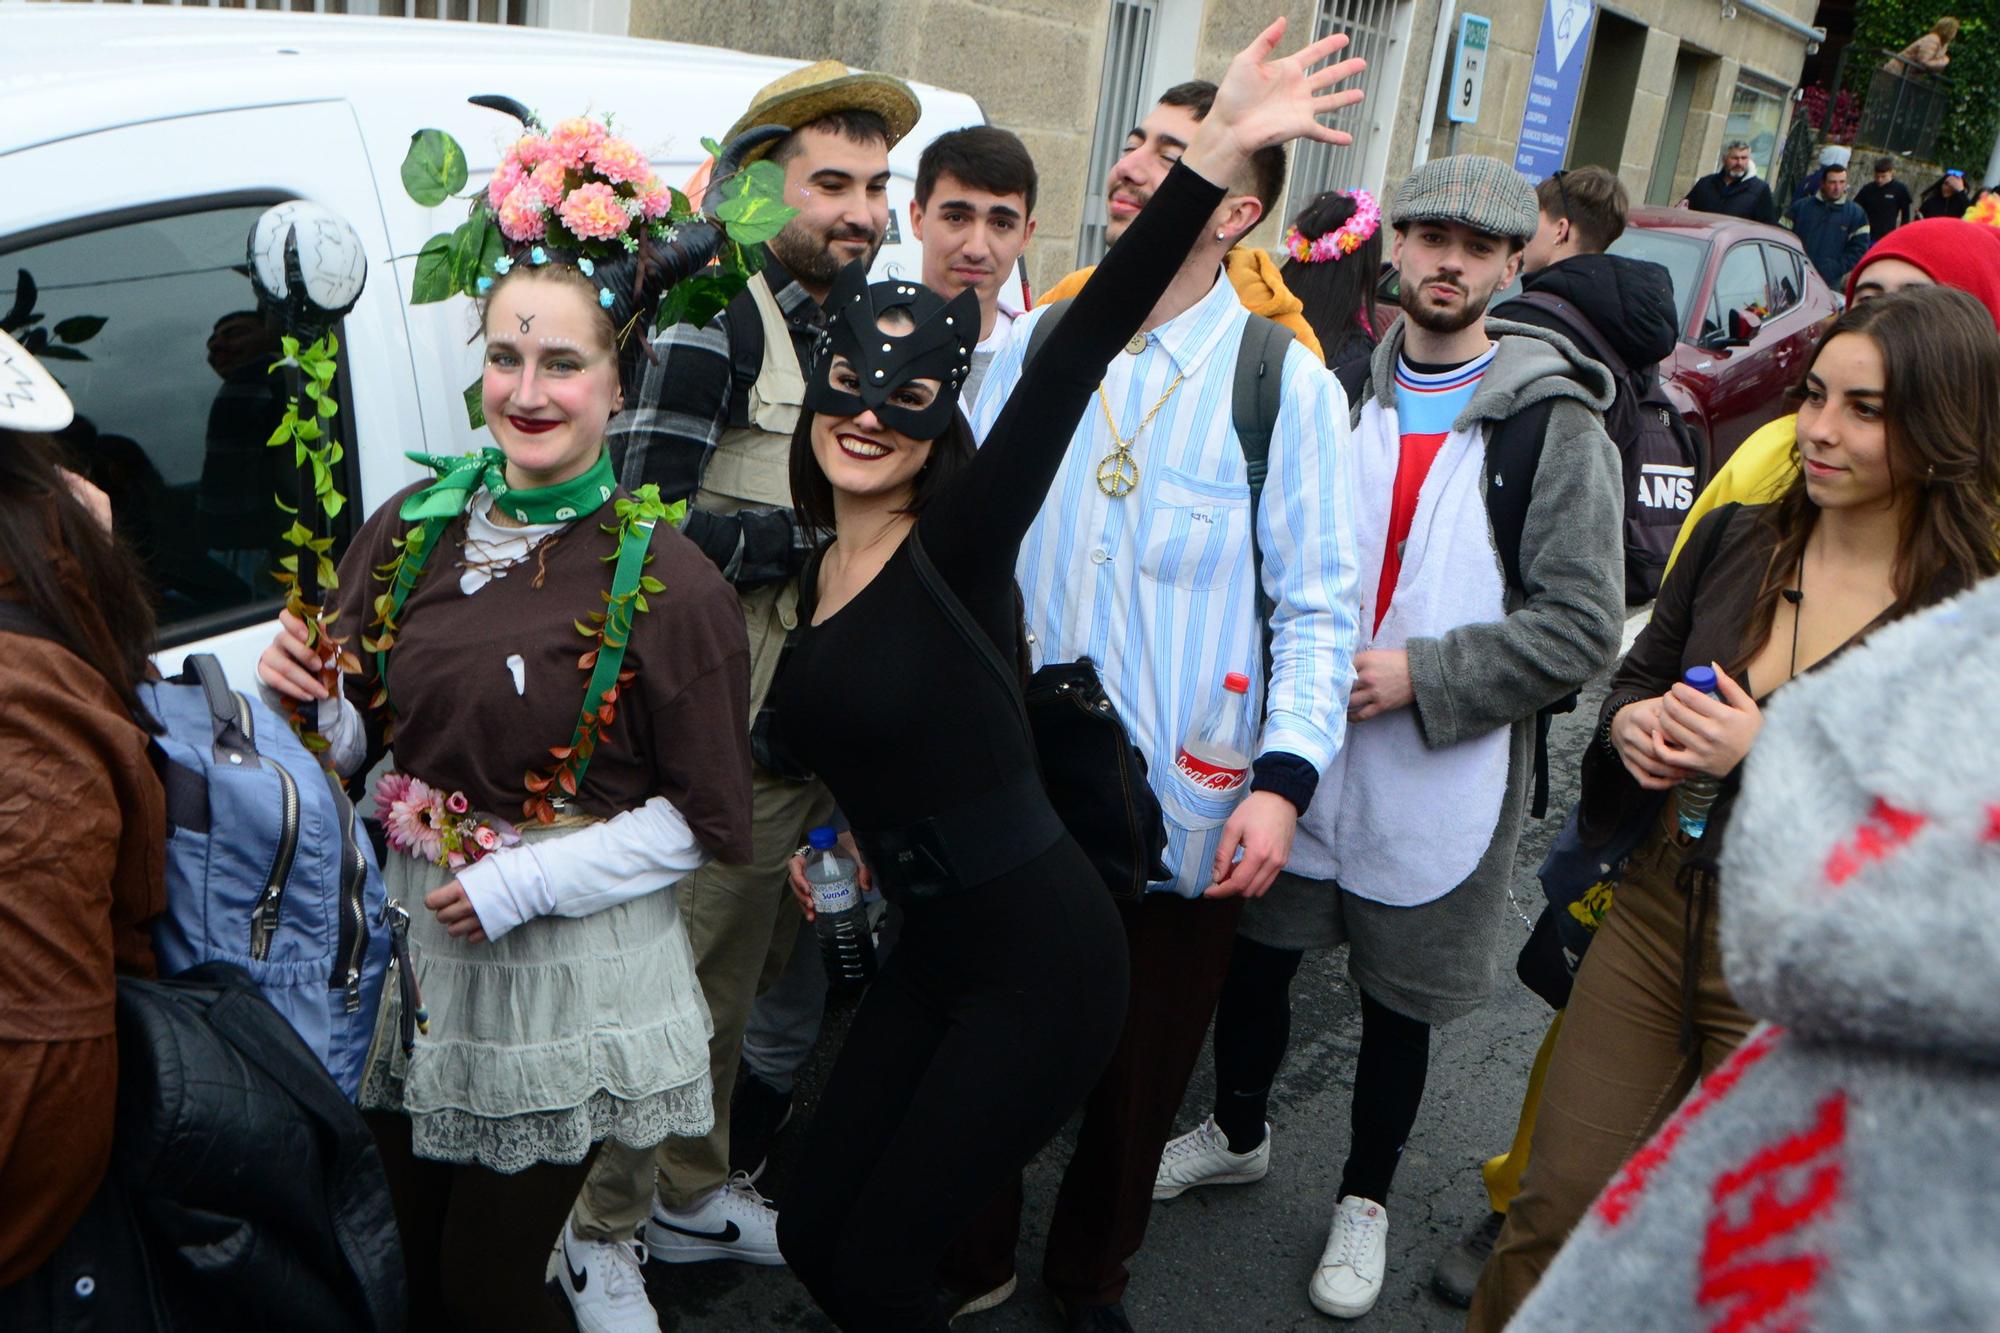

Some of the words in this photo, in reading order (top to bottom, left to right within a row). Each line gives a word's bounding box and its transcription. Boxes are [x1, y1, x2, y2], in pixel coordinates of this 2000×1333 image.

[1466, 56, 1477, 71] km
[1463, 78, 1472, 106] 9
[1638, 475, 1694, 511] ANS
[1177, 755, 1243, 791] Coca-Col
